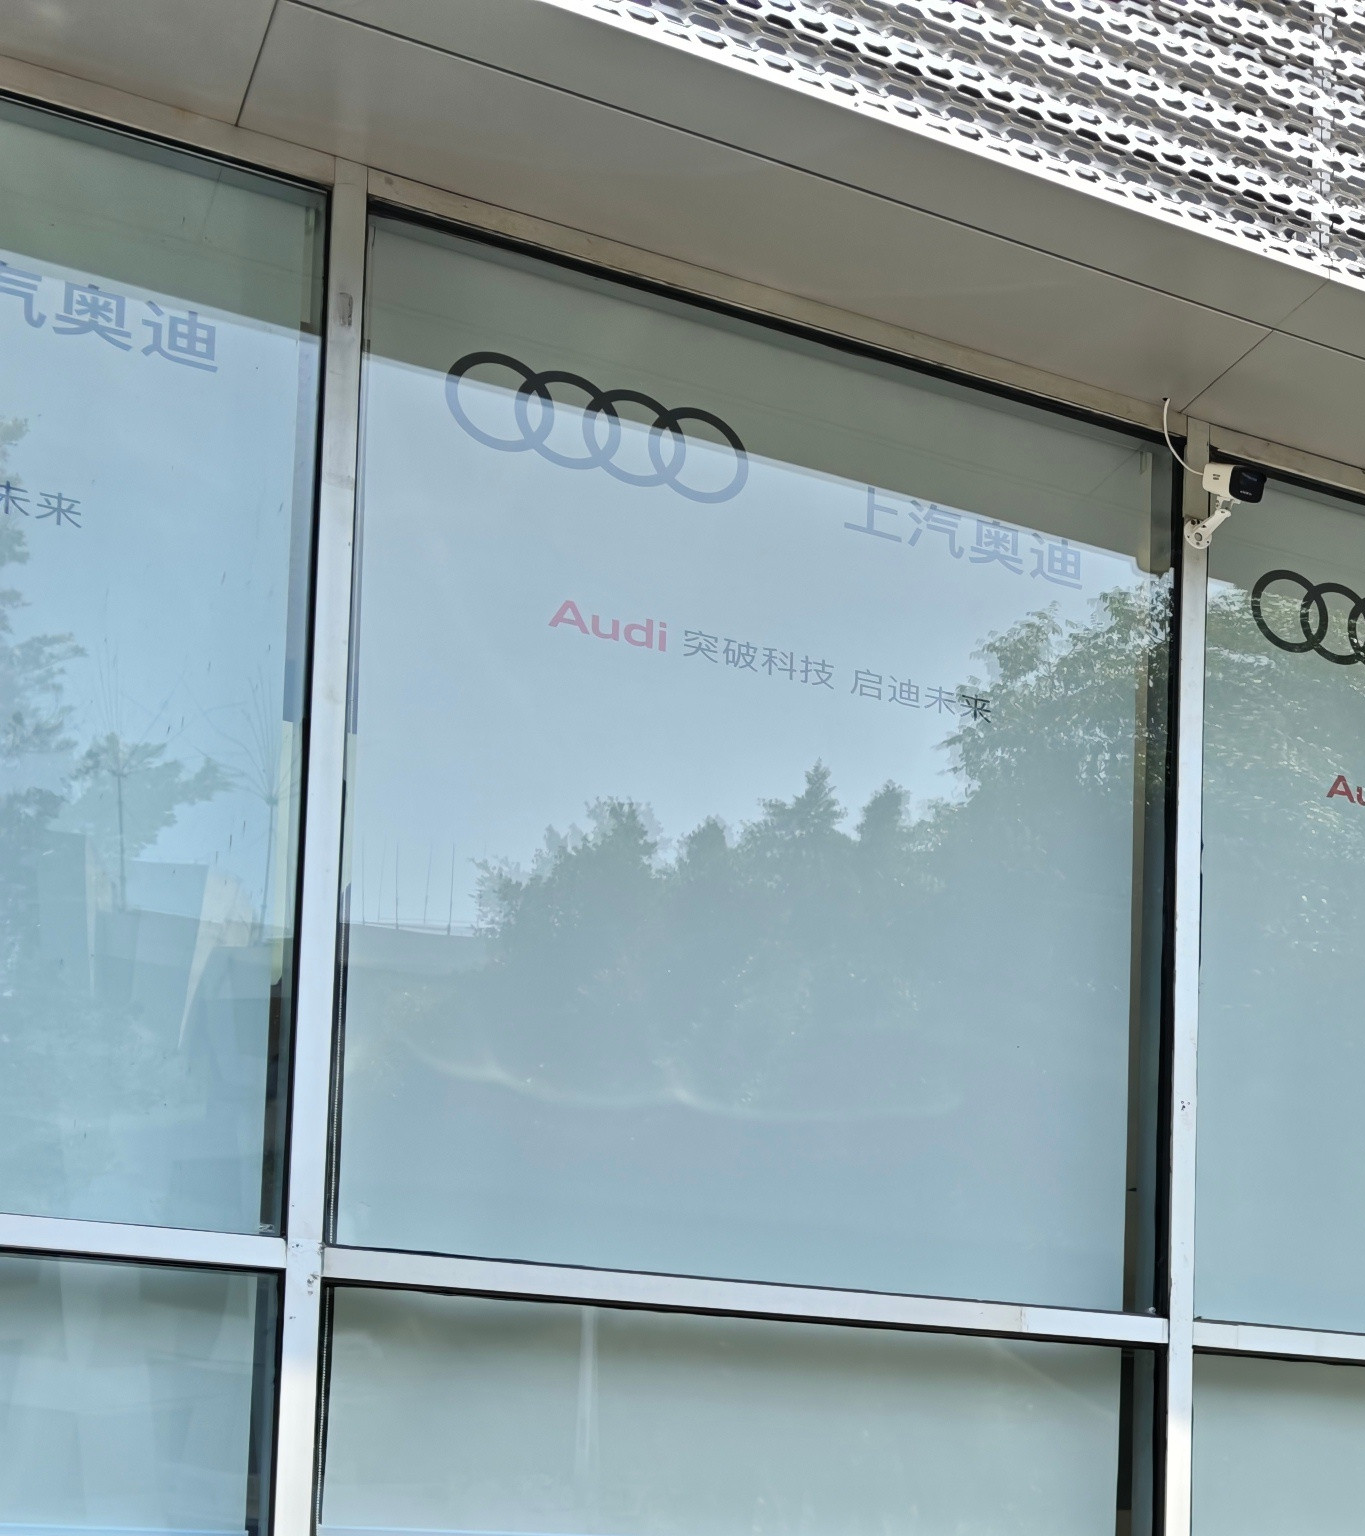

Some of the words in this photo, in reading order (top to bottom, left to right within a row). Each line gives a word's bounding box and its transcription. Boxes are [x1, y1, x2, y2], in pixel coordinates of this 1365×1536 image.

[843, 483, 1083, 591] 上汽奥迪
[548, 599, 667, 652] Audi
[683, 629, 835, 690] 突破科技
[850, 668, 992, 724] 启迪未来
